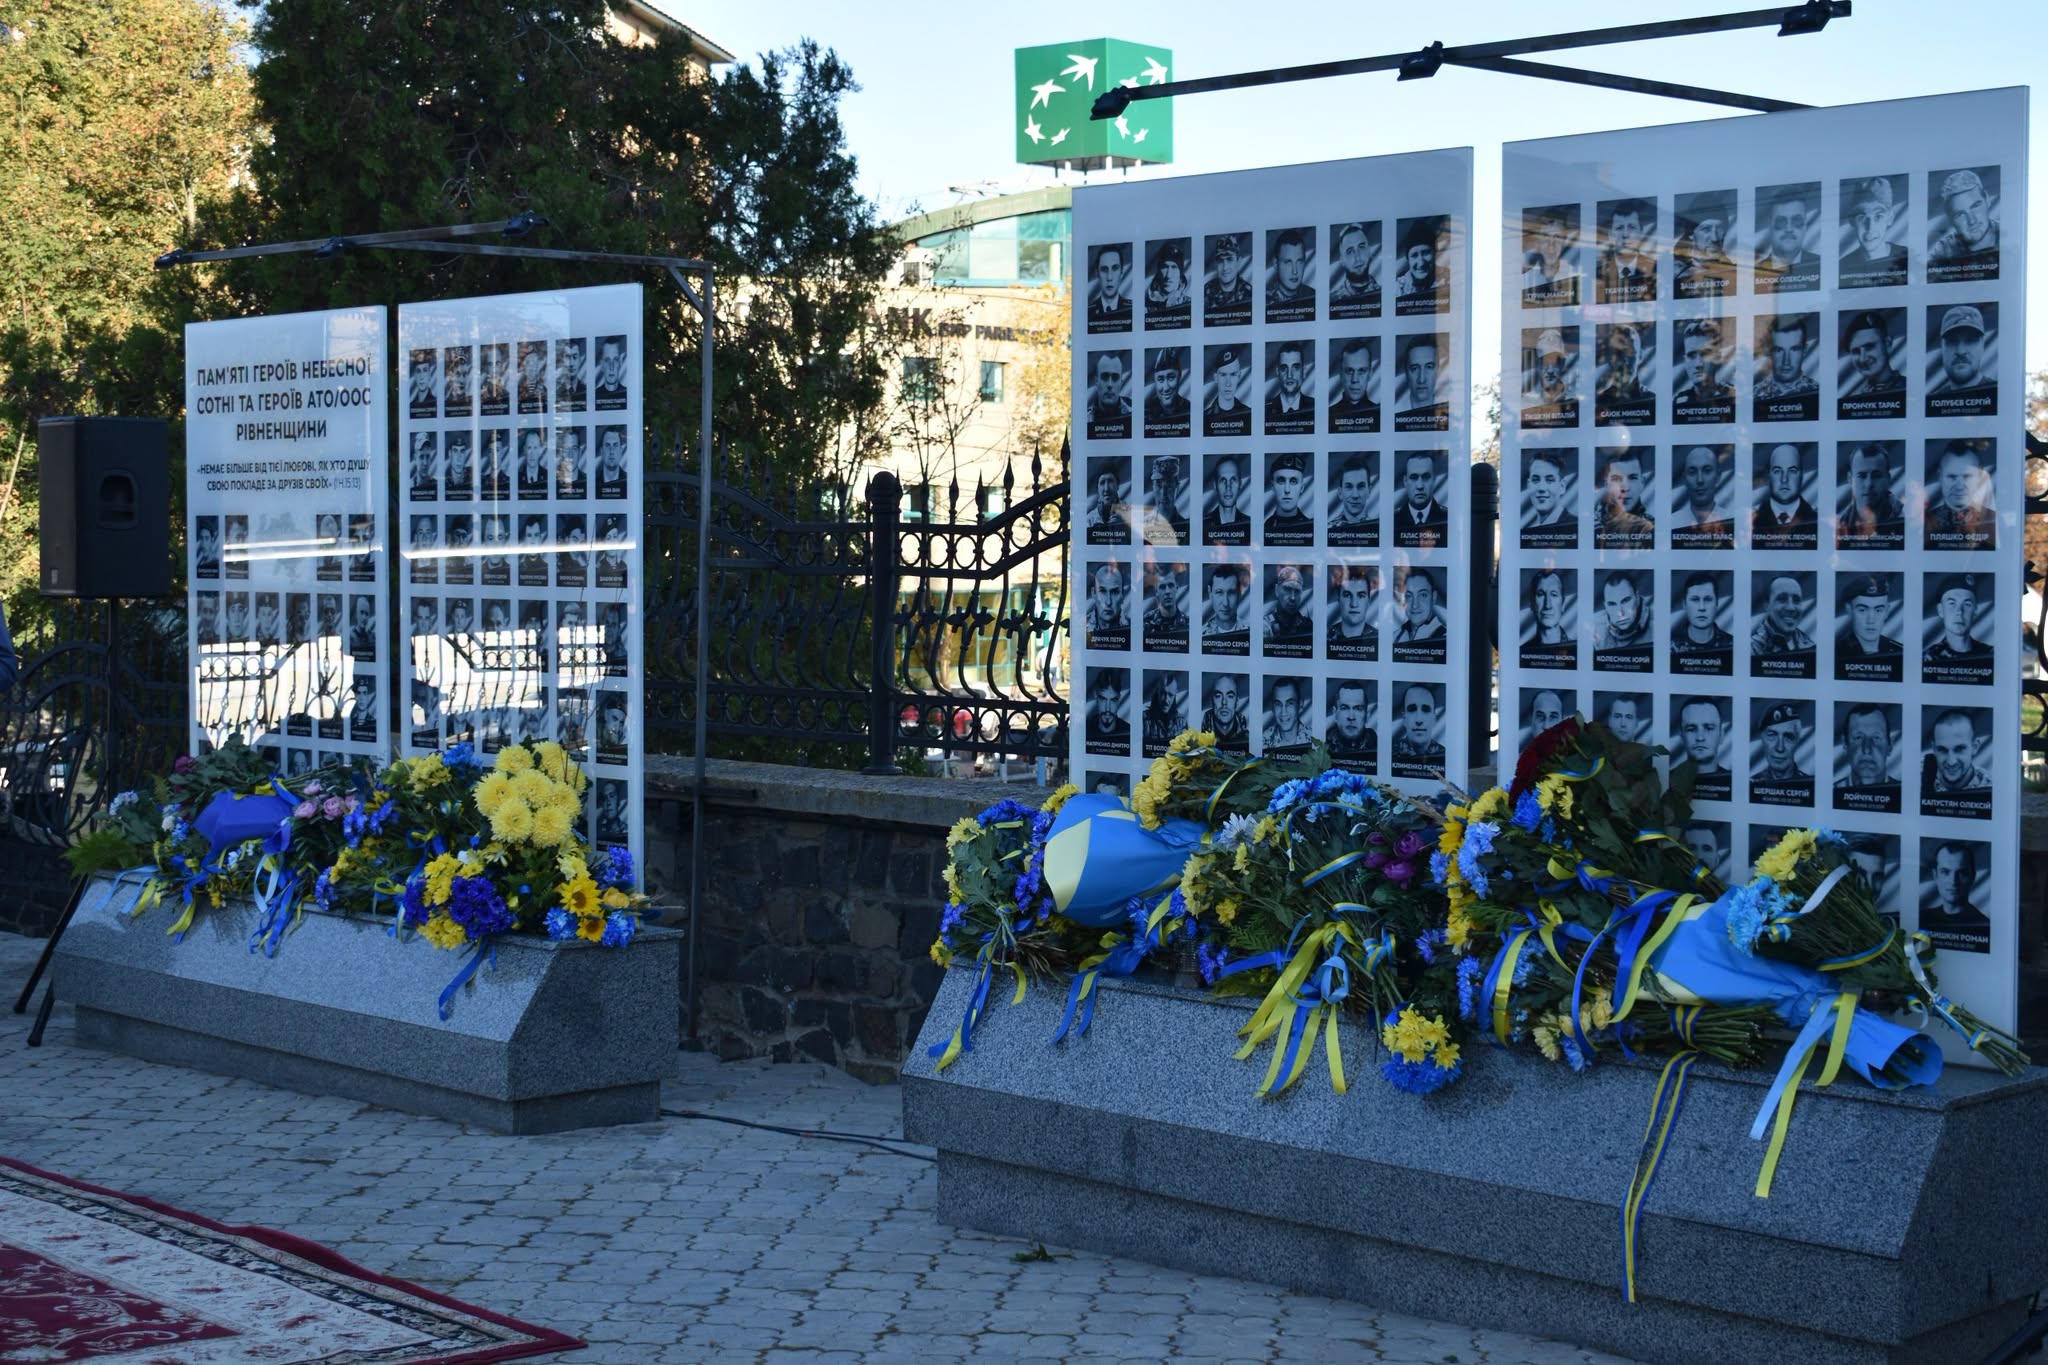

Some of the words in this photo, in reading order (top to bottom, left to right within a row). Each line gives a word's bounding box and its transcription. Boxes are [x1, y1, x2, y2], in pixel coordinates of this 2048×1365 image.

[197, 365, 249, 386] ПАМ'ЯТІ
[253, 359, 297, 382] ГЕРОЇВ
[302, 353, 371, 379] НЕБЕСНОЇ
[197, 395, 234, 415] СОТНІ
[238, 394, 254, 411] ТА
[258, 388, 303, 411] ГЕРОЇВ
[307, 386, 371, 409] АТО/ООС
[1965, 396, 1991, 406] СЕРГІЙ
[1708, 405, 1731, 414] СЕРГІЙ
[1779, 403, 1802, 412] СЕРГІЙ
[1843, 402, 1877, 411] ПРОНЧУК
[1878, 400, 1901, 409] ТАРАС
[1622, 409, 1650, 417] МИКОЛА
[1229, 420, 1244, 428] ЮРІЙ
[1355, 416, 1373, 425] СЕРГІЙ
[236, 419, 327, 441] РІВНЕНЩИНИ
[1106, 424, 1124, 432] АНДРІЙ
[1171, 422, 1190, 430] АНДРІЙ
[226, 462, 253, 474] БІЛЬШЕ
[254, 461, 267, 474] ВІД
[268, 459, 283, 472] ТІЄЇ
[318, 460, 328, 471] ЯК
[329, 459, 346, 470] ХТО
[347, 457, 370, 471] ДУШУ
[207, 480, 229, 491] СВОЮ
[231, 478, 266, 491] ПОКЛАДЕ
[267, 478, 277, 490] ЗА
[278, 478, 304, 491] ДРУЗІВ
[1419, 532, 1440, 540] РОМАН
[1631, 532, 1652, 540] СЕРГІЙ
[1965, 532, 1989, 542] ФЕДІР
[1232, 640, 1249, 648] СЕРГІЙ
[1356, 645, 1375, 653] СЕРГІЙ
[1430, 648, 1445, 656] ОЛЕГ
[1596, 656, 1631, 664] КОЛЕСНИК
[1631, 655, 1650, 665] ЮРІЙ
[1703, 657, 1722, 667] ЮРІЙ
[1761, 660, 1787, 669] ЖУКОВ
[1788, 661, 1805, 669] ІВАН
[1845, 663, 1873, 673] БОРСУК
[1874, 664, 1892, 673] ІВАН
[1949, 667, 1993, 677] ОЛЕКСАНДР
[1110, 741, 1130, 750] ДМИТРО
[1358, 759, 1377, 768] РУСЛАН
[1785, 788, 1810, 798] СЕРГІЙ
[1874, 794, 1891, 803] ІГОР
[1921, 798, 1959, 808] КАПУСТЯН
[1959, 799, 1992, 810] ОЛЕКСІЙ
[1960, 934, 1989, 944] РОМАН
